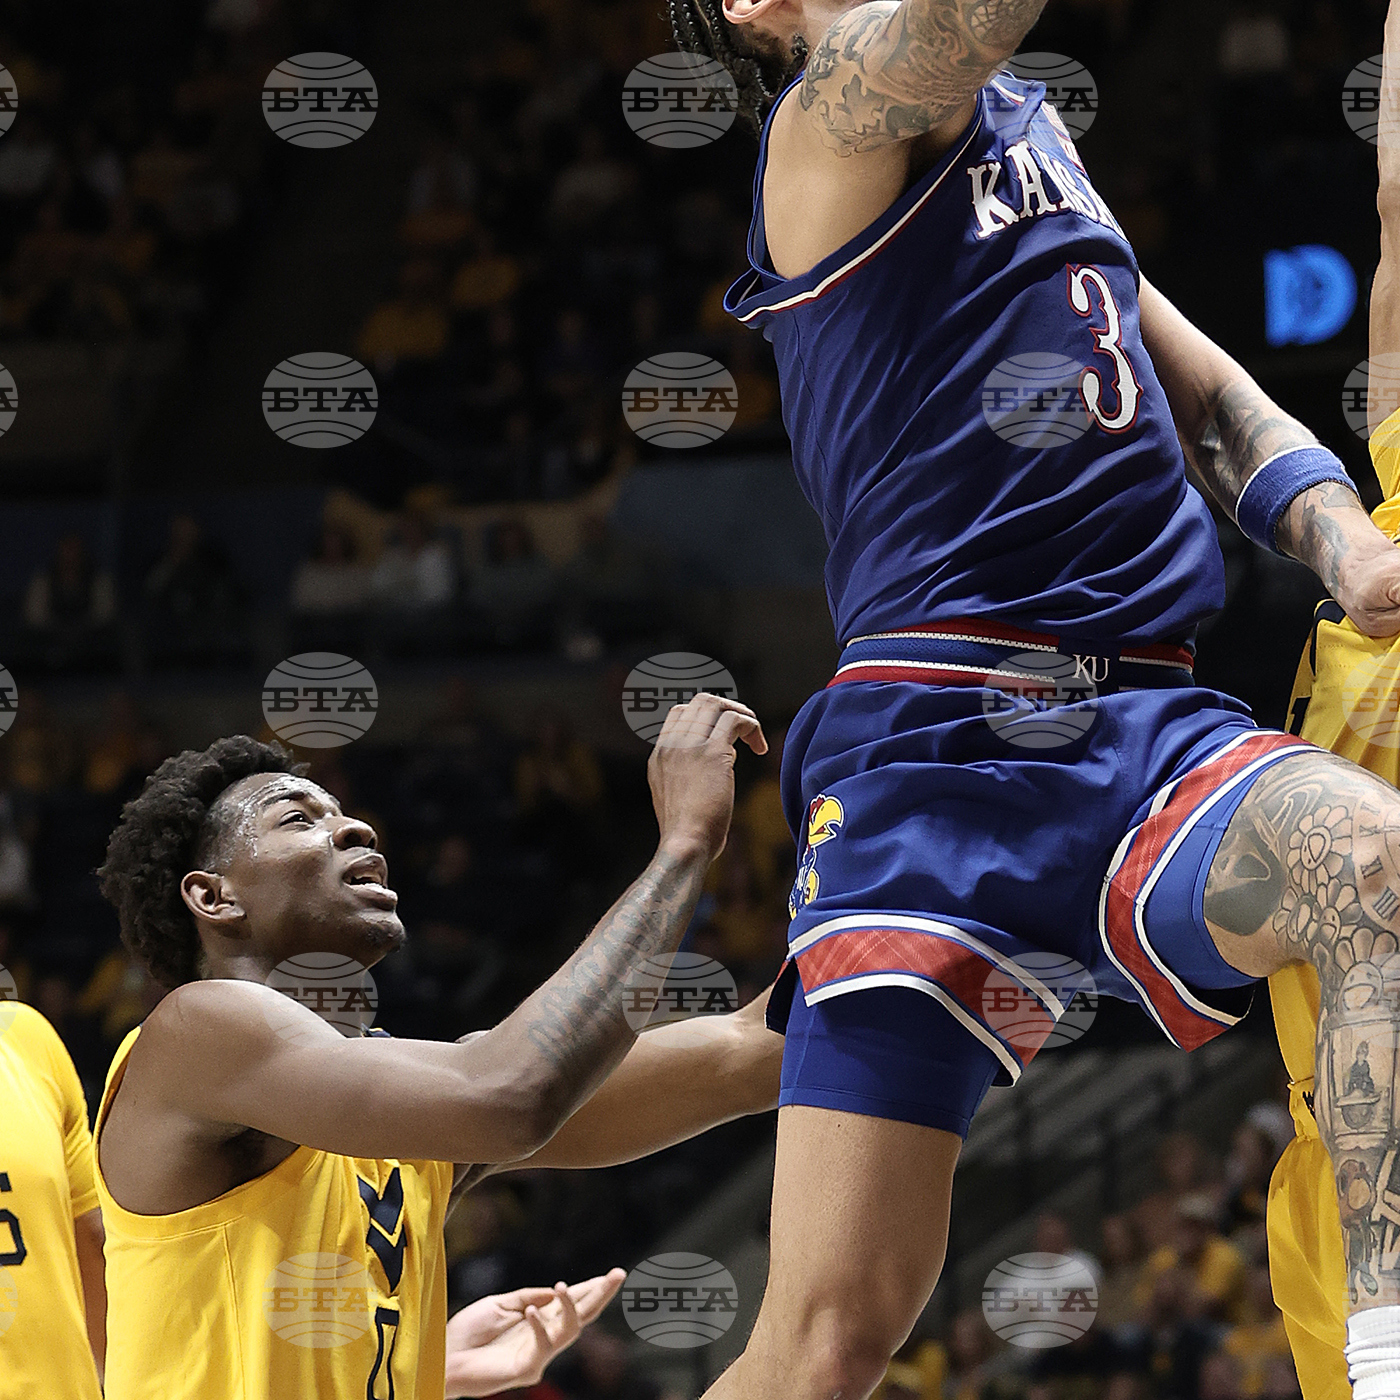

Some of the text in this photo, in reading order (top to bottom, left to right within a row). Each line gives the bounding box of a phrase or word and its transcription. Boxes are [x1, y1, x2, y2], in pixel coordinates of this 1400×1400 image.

[966, 139, 1132, 242] KANSA
[1066, 262, 1143, 434] 3
[1072, 653, 1110, 686] KU
